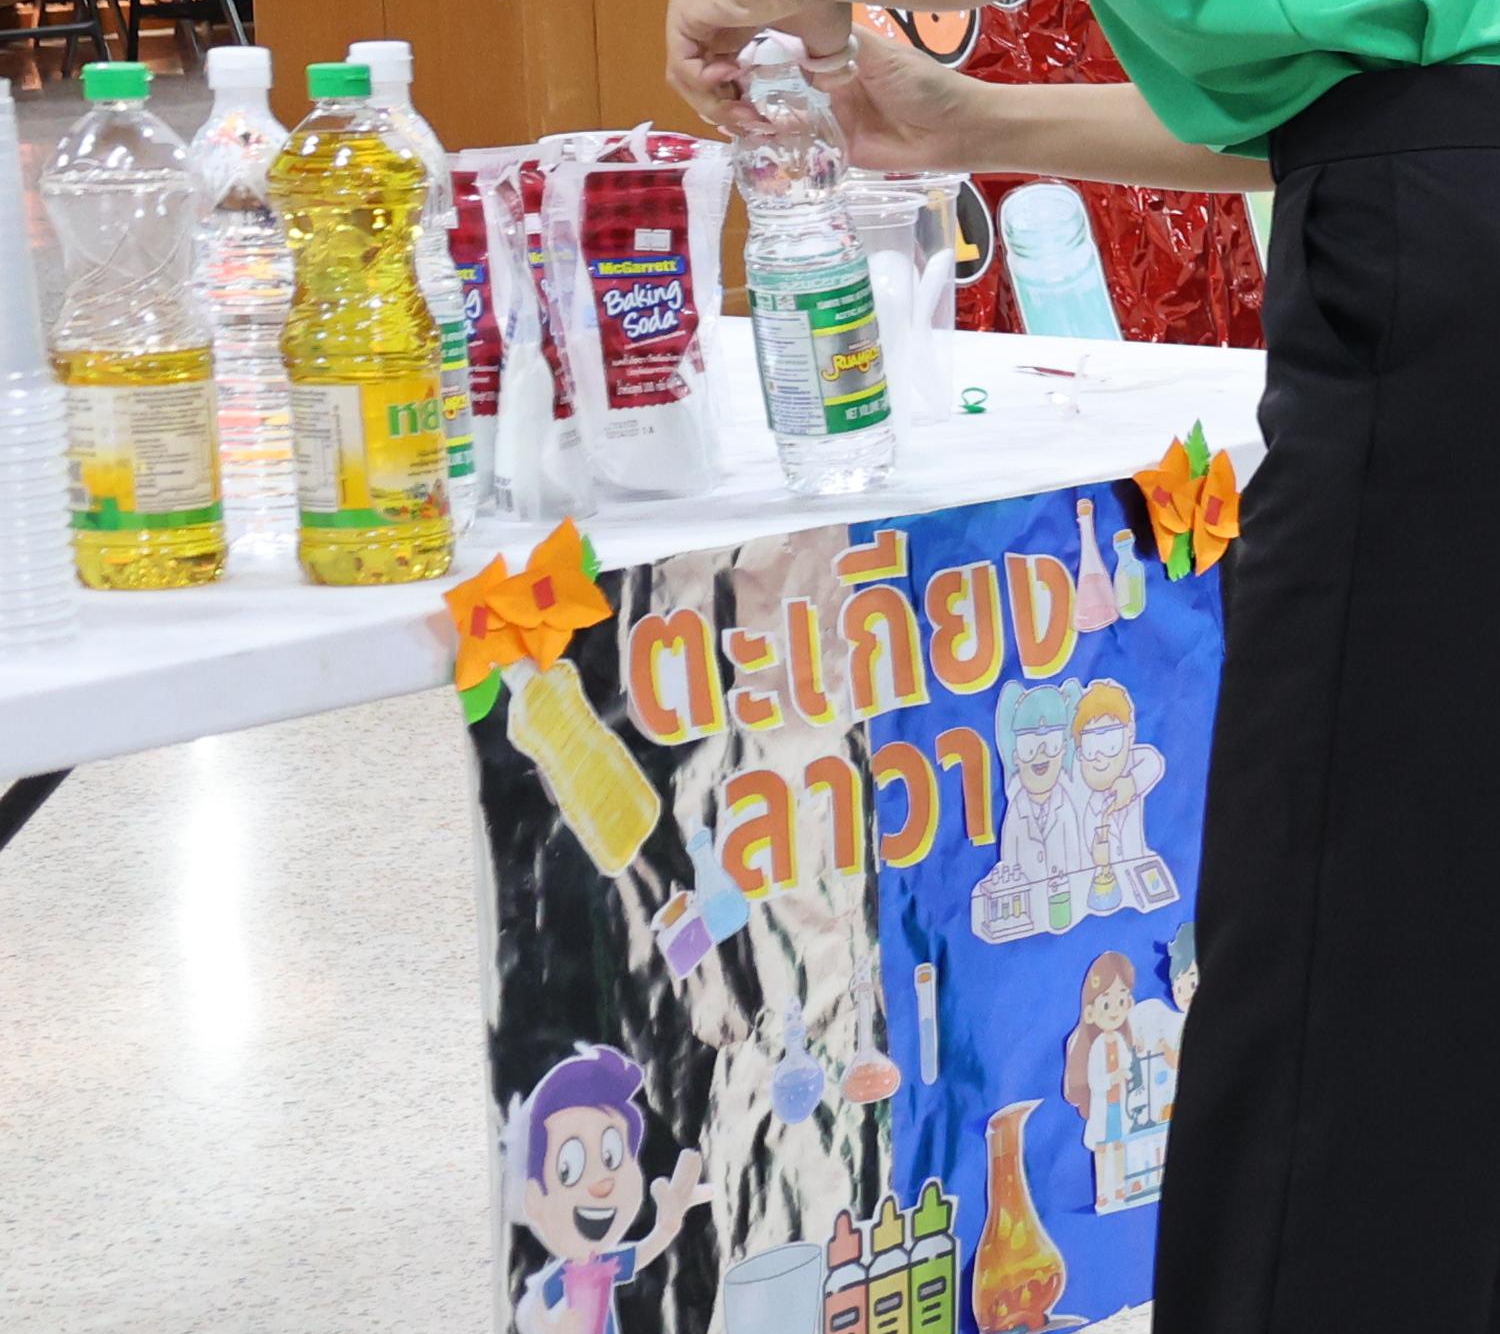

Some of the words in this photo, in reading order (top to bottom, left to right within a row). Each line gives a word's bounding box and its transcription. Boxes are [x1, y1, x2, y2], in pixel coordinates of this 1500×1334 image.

[598, 260, 677, 275] McGarrett
[603, 280, 683, 316] Baking
[622, 307, 678, 339] Soda
[626, 528, 1081, 746] ตะเกียง
[722, 726, 996, 903] ลาวา
